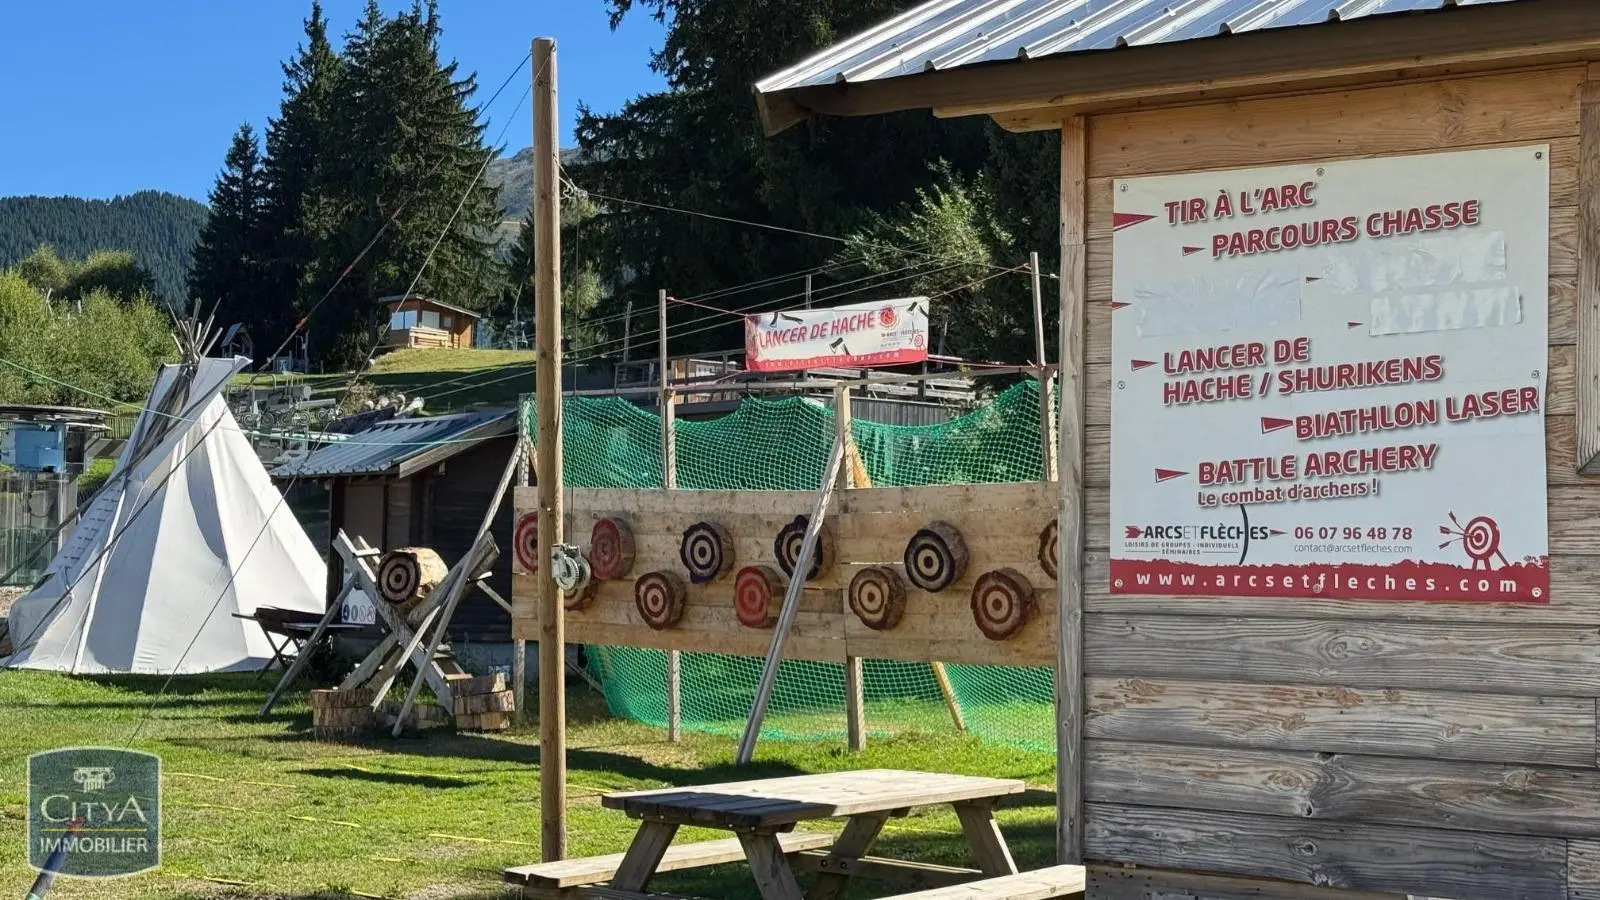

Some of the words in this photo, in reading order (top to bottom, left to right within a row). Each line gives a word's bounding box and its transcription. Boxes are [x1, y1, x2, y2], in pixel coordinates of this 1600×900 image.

[1164, 198, 1206, 224] TIR
[1213, 189, 1232, 216] À
[1240, 181, 1315, 213] L'ARC
[1211, 215, 1358, 258] PARCOURS
[1365, 199, 1479, 237] CHASSE
[759, 325, 806, 348] LANCER
[810, 320, 828, 339] DE
[830, 311, 876, 336] HACHE
[1163, 342, 1265, 374] LANCER
[1274, 337, 1309, 361] DE
[1163, 374, 1251, 405] HACHE
[1260, 373, 1270, 396] /
[1277, 354, 1443, 393] SHURIKENS
[1296, 399, 1437, 439] BIATHLON
[1445, 386, 1539, 420] LASER
[1198, 454, 1296, 485] BATTLE
[1303, 443, 1437, 476] ARCHERY
[1198, 489, 1217, 506] Le
[1221, 484, 1283, 503] combat
[1287, 480, 1366, 500] d'archers
[1371, 479, 1379, 493] !
[1294, 527, 1314, 540] 06
[1318, 527, 1337, 540] 07
[1343, 527, 1362, 540] 96
[1366, 527, 1387, 540] 48
[1392, 527, 1413, 540] 78
[1294, 543, 1413, 554] contact@arcsetfleches.com
[1136, 572, 1518, 593] www.arcsetfleches.com
